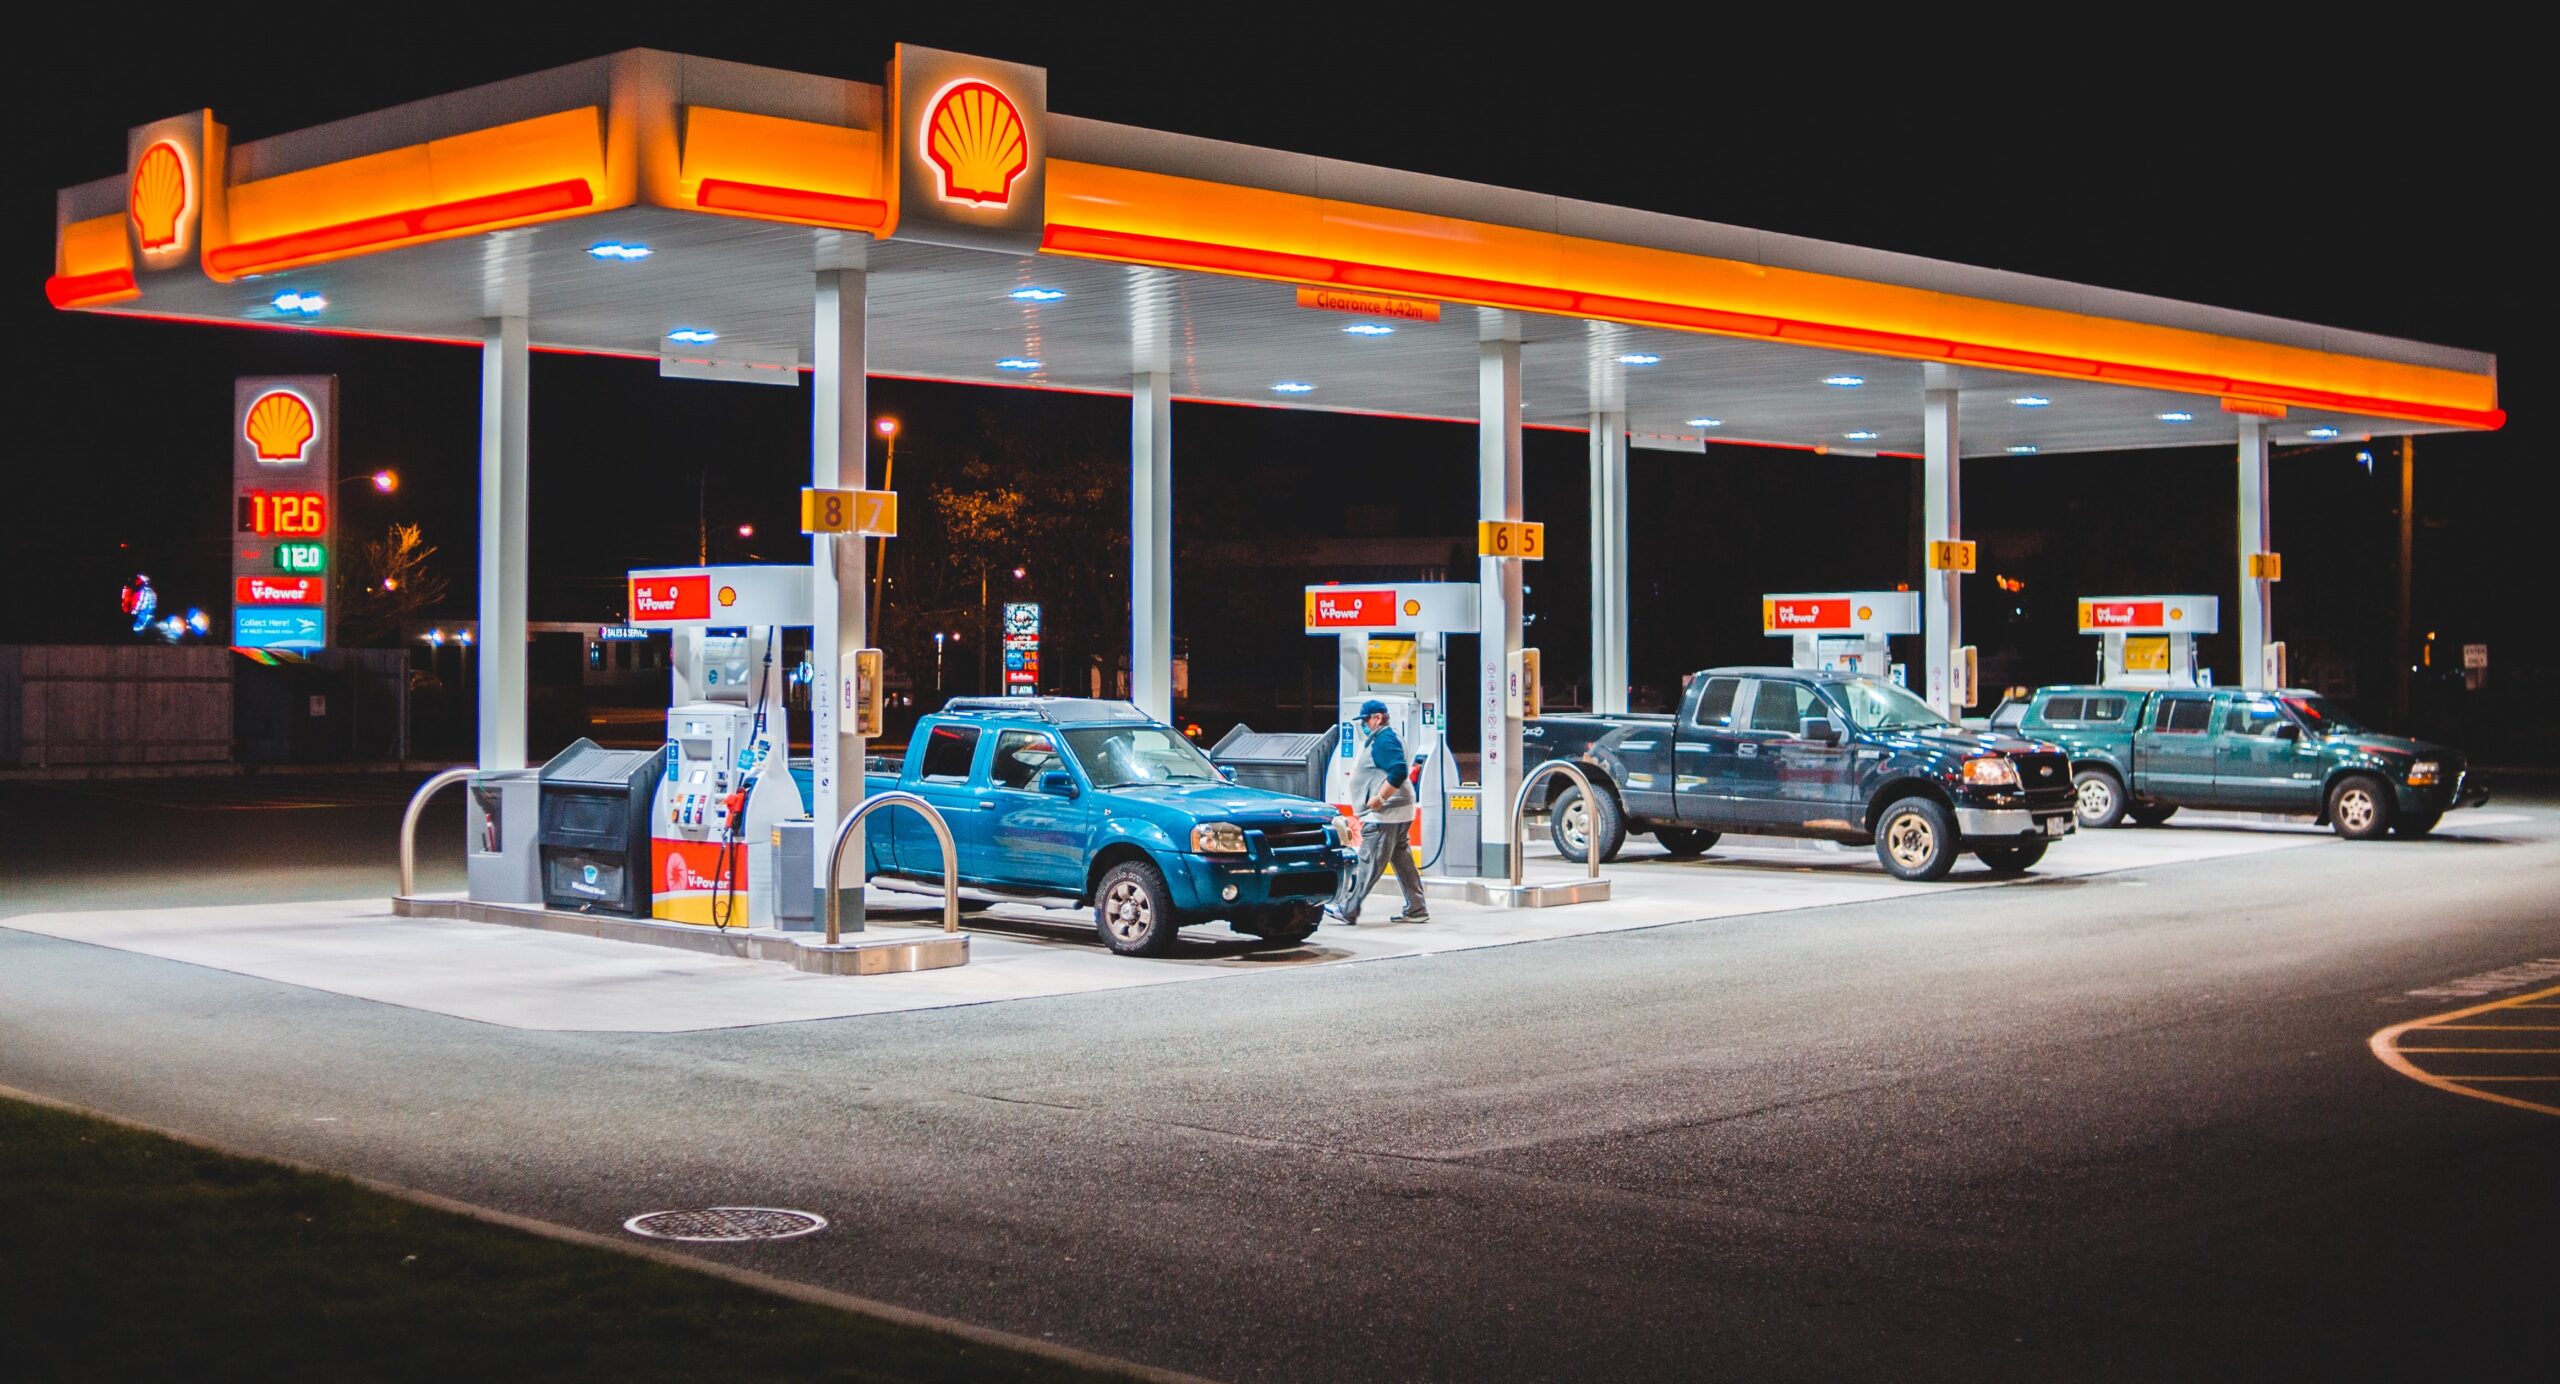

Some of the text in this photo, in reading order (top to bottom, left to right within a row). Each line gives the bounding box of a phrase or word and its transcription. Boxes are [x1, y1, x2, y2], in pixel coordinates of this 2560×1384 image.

[1317, 292, 1423, 318] Clearance 4.42m
[825, 496, 884, 528] 8 7
[1496, 527, 1535, 552] 6 5
[1943, 546, 1970, 567] 4 3
[251, 586, 305, 599] V-Power
[637, 598, 676, 610] V-Power
[1320, 600, 1335, 608] Shell
[1308, 610, 1314, 626] 6
[1320, 608, 1360, 619] V-Power
[1780, 612, 1816, 623] V-Power
[239, 618, 267, 627] Collect
[607, 628, 622, 637] SALES
